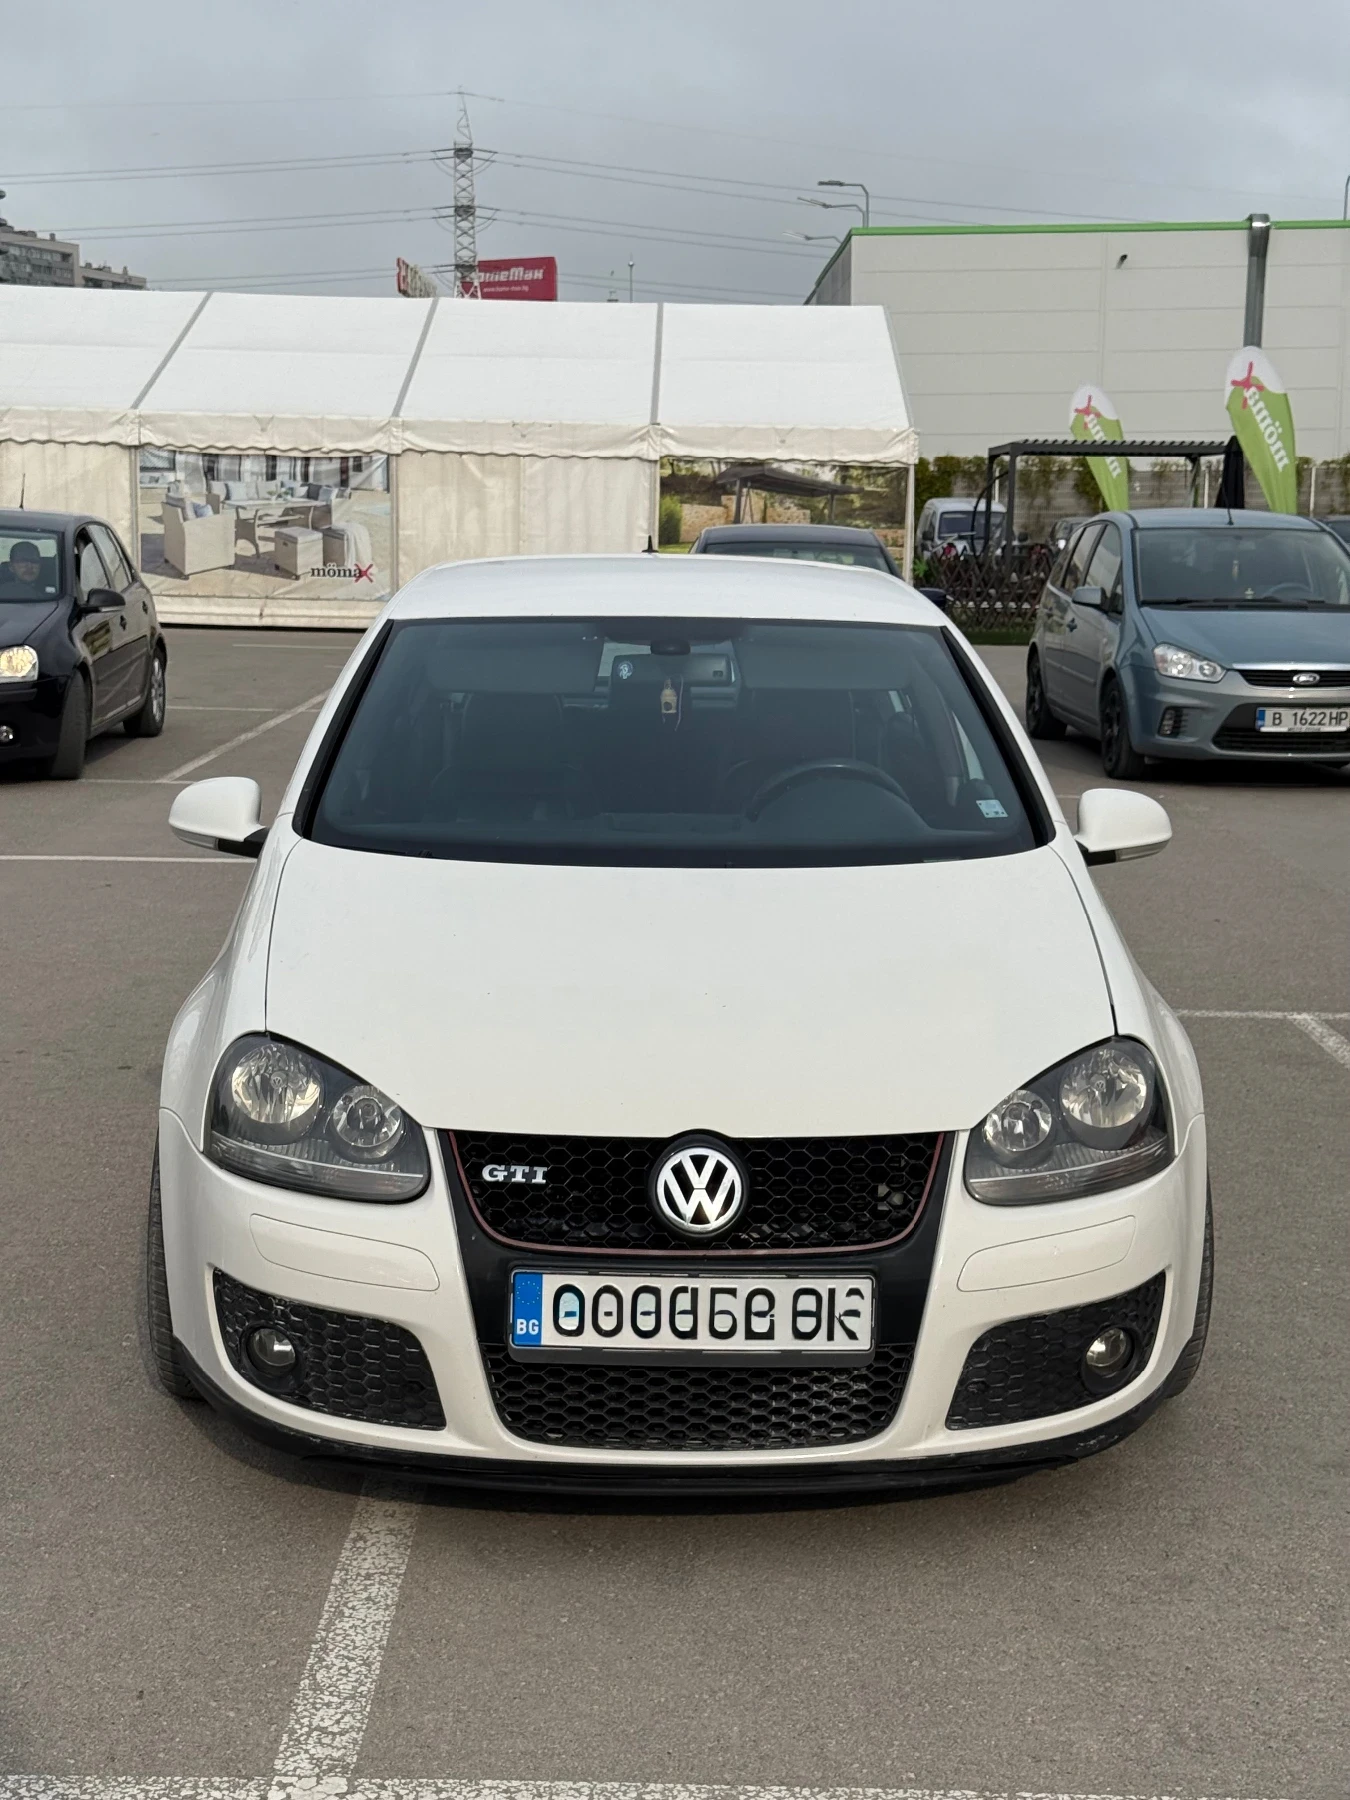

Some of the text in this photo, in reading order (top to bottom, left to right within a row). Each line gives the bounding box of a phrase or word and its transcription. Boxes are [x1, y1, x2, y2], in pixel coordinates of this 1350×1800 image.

[468, 267, 545, 283] omeMax
[1272, 711, 1283, 726] B
[482, 1164, 548, 1184] GTI
[516, 1319, 539, 1336] BG
